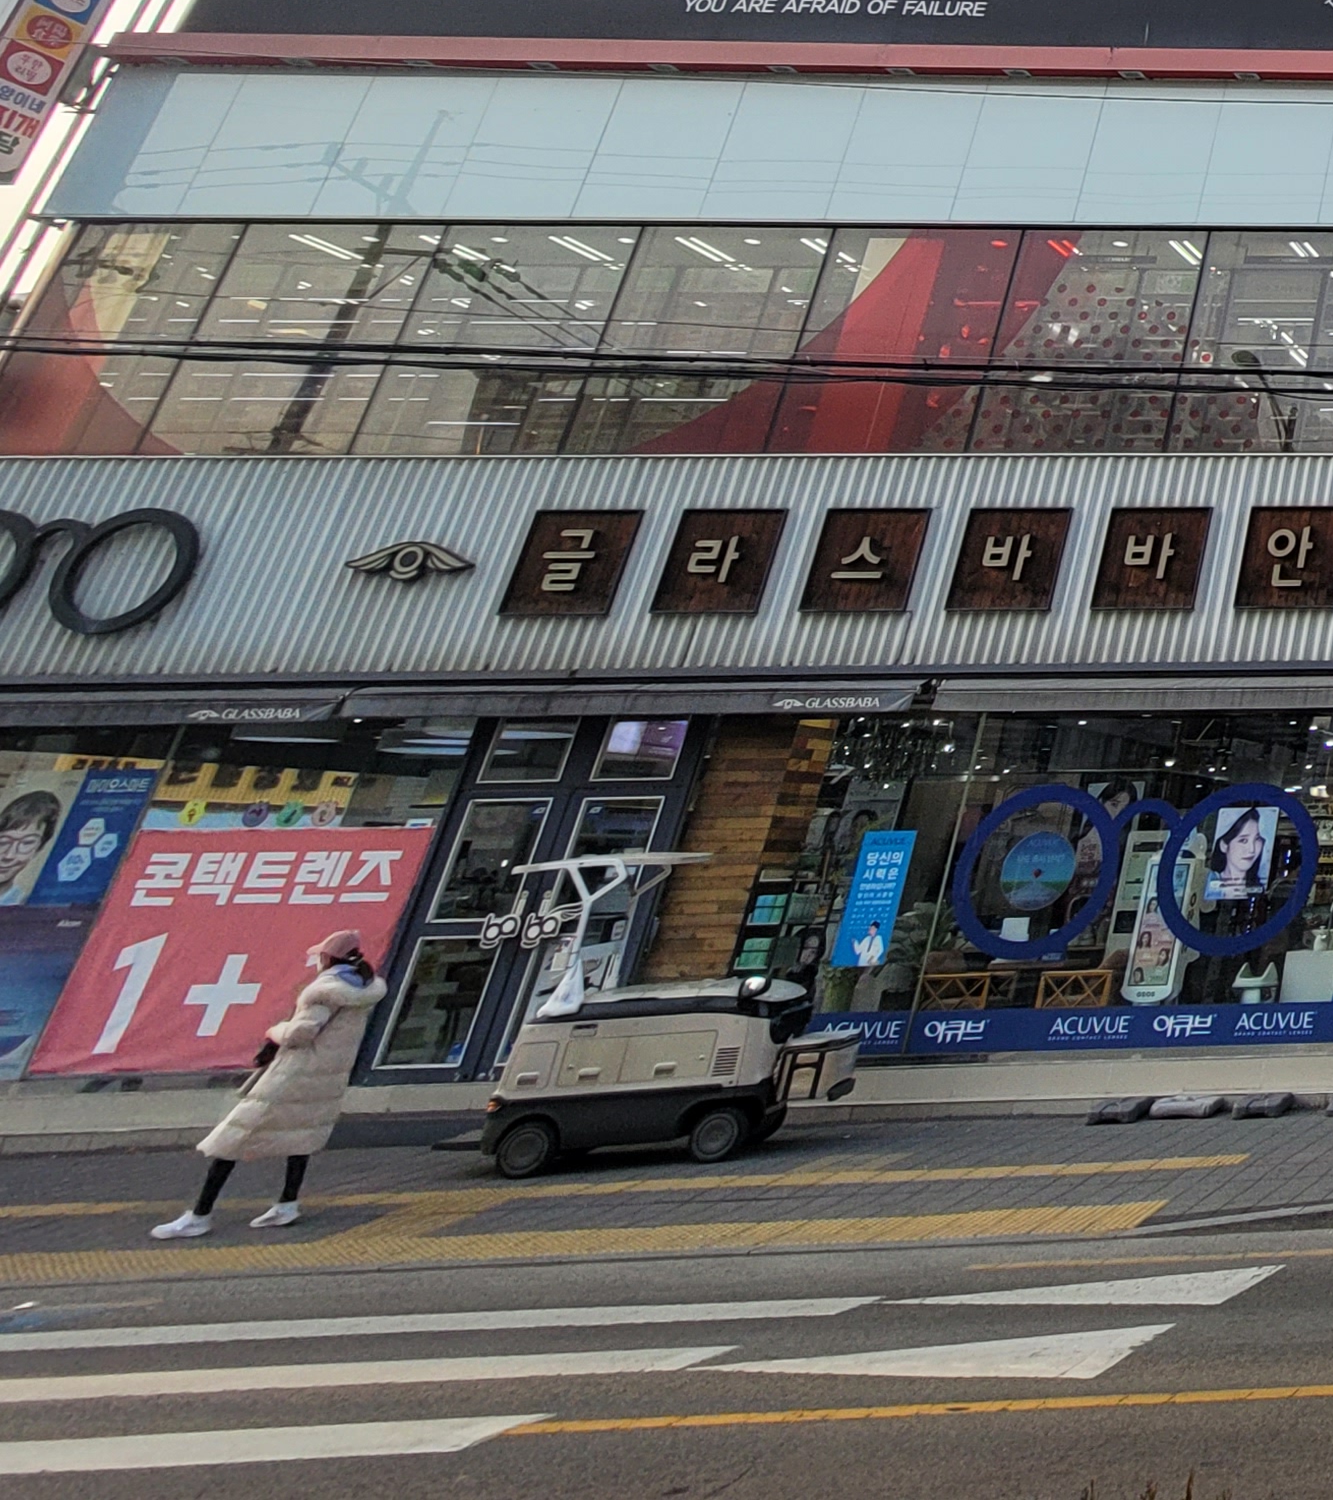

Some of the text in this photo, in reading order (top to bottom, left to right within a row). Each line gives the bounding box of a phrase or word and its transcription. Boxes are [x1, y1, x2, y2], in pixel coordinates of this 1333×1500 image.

[866, 0, 897, 17] OF
[901, 0, 987, 19] FAILURE
[806, 696, 881, 710] GLASSBABA
[222, 707, 301, 721] GLASSBABA
[866, 851, 904, 866] 당신의
[130, 850, 403, 908] 콘택트렌즈
[924, 1019, 989, 1044] 아큐브
[1049, 1015, 1133, 1035] ACUVUE
[1153, 1013, 1216, 1038] 아큐브
[1234, 1011, 1317, 1031] ACUVUE
